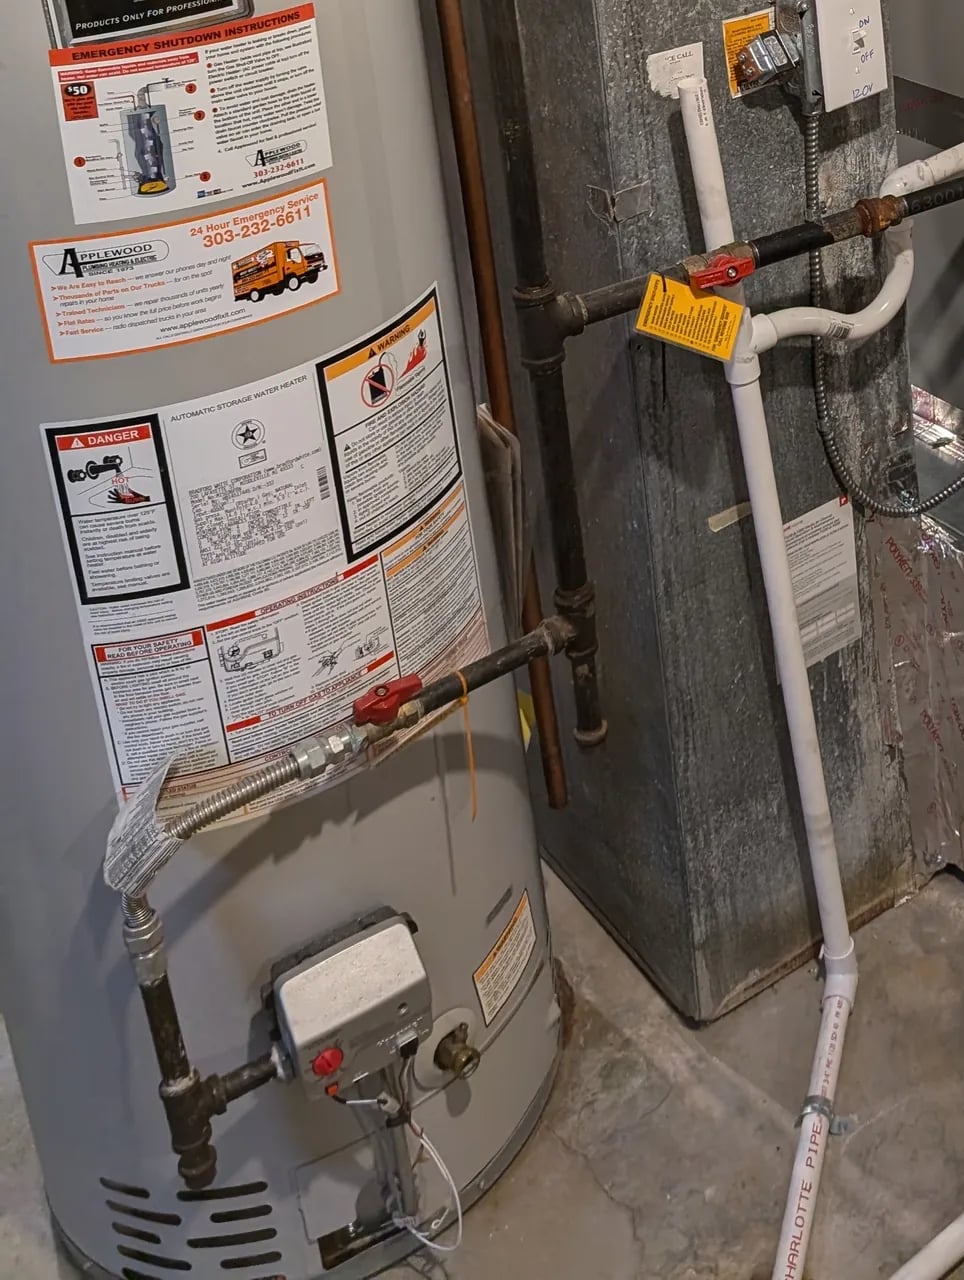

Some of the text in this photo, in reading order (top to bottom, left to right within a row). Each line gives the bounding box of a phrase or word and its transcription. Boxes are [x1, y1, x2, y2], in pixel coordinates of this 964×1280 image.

[75, 17, 120, 30] PRODUCTS
[122, 11, 145, 23] ONLY
[147, 8, 164, 17] FOR
[859, 17, 870, 28] ON
[72, 11, 300, 61] EMERGENCY SHUTDOWN INSTRUCTIONS
[677, 50, 693, 59] CALL
[861, 51, 874, 63] OFF
[67, 85, 88, 95] $50
[852, 84, 873, 99] 120V
[254, 142, 301, 167] APPLEWOOD
[253, 158, 304, 178] 303-232-6611
[190, 193, 319, 236] 24 Hour Emergency Service
[203, 205, 310, 248] 303-232-6611
[58, 244, 153, 278] APPLEWOOD
[145, 271, 164, 279] answer
[176, 264, 195, 273] phones
[196, 261, 206, 269] day
[218, 255, 231, 263] night
[59, 292, 92, 300] Thousands
[144, 280, 166, 289] Trucks
[201, 270, 213, 278] spot
[87, 304, 125, 314] Technicians
[144, 297, 160, 306] repair
[160, 292, 188, 301] thousands
[209, 283, 224, 292] yearly
[158, 305, 171, 313] price
[204, 294, 222, 303] begins
[128, 318, 157, 328] dispatched
[182, 311, 194, 319] your
[160, 308, 246, 332] www.applewoodfixit.com
[377, 324, 411, 350] WARNING
[170, 375, 307, 422] AUTOMATIC STORAGE WATER HEATER
[88, 430, 140, 446] DANGER
[260, 578, 339, 614] OPERATING INSTRUCTIONS
[118, 645, 132, 653] FOR
[153, 638, 178, 647] SAFETY
[127, 648, 153, 656] BEFORE
[154, 641, 192, 652] OPERATING
[267, 671, 363, 719] TO TURN OFF GAS TO APPLIANCE
